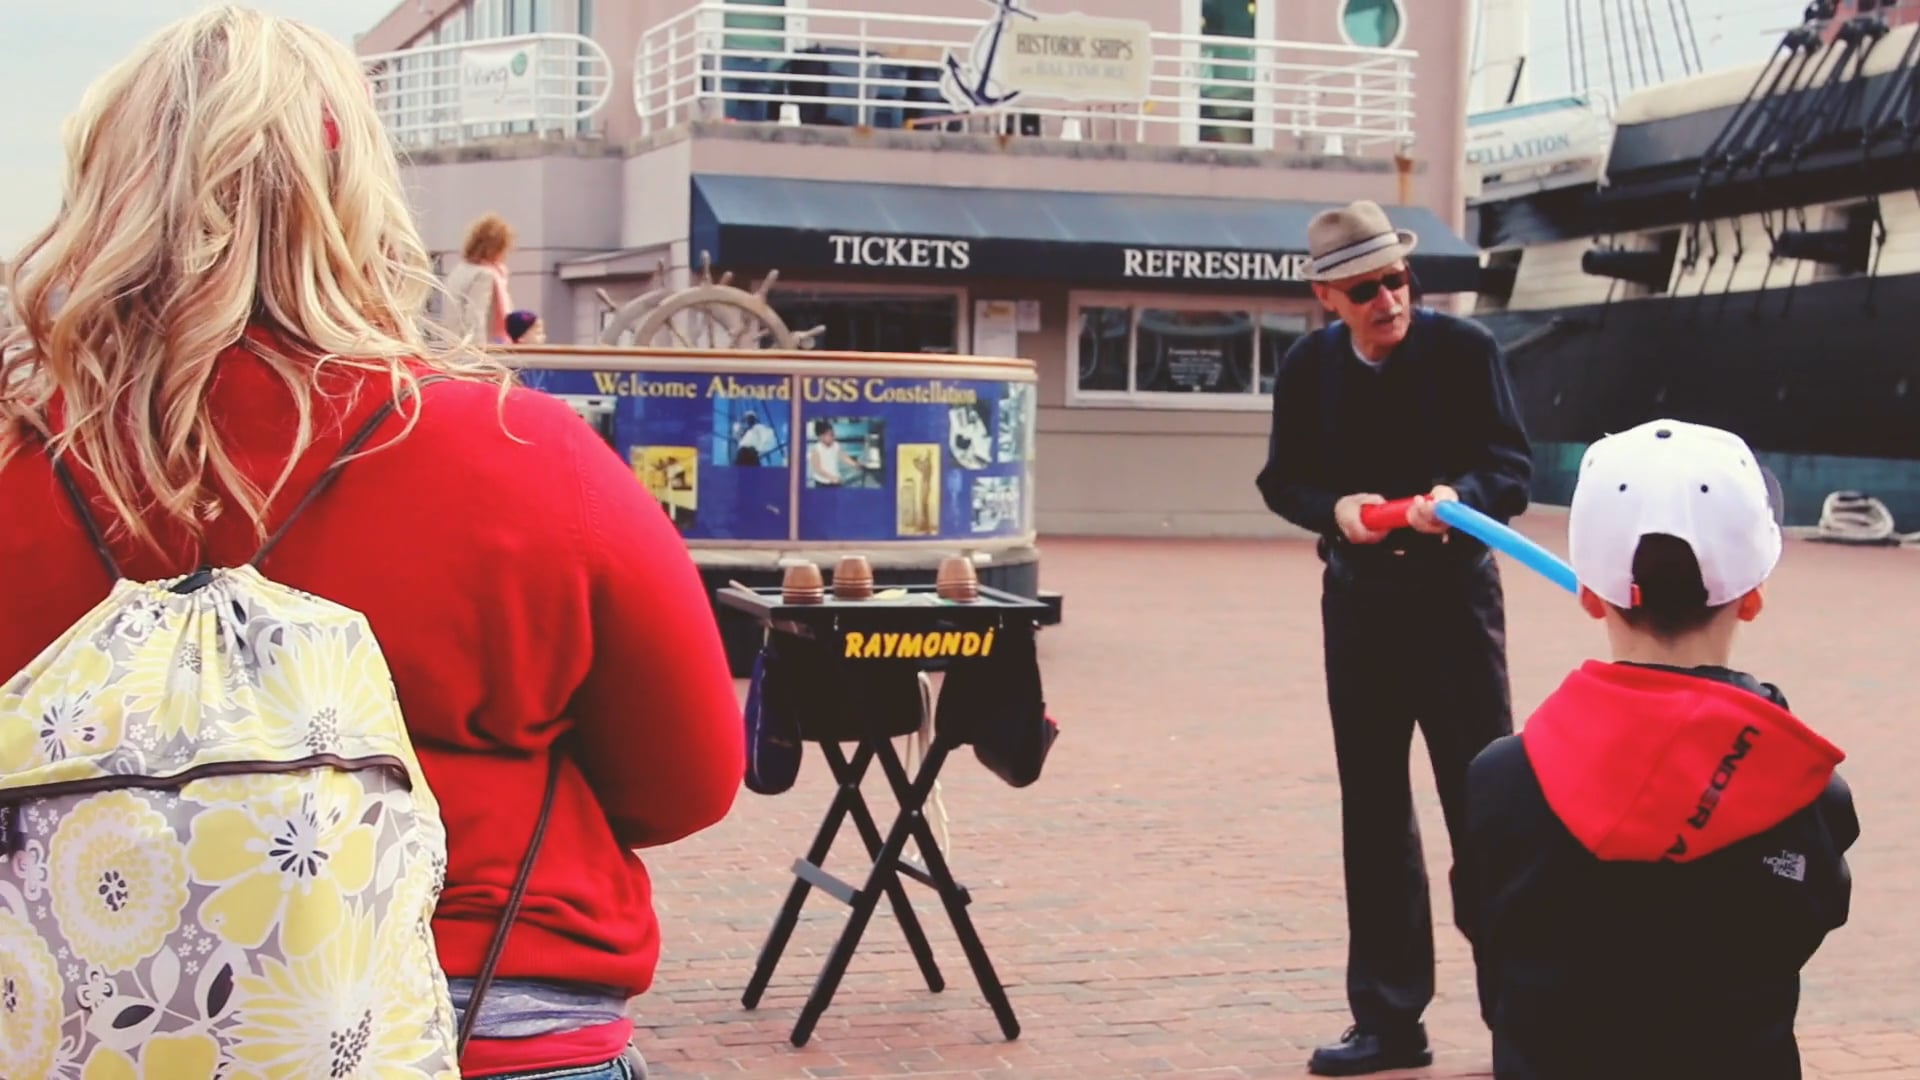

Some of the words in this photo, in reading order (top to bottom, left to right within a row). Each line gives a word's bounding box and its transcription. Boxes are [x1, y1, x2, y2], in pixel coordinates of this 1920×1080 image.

[1016, 33, 1085, 57] HISTORIC
[1090, 38, 1134, 61] SHIPS
[1466, 134, 1570, 164] ELLATION
[828, 235, 970, 270] TICKETS
[593, 371, 698, 399] Welcome
[706, 375, 790, 400] Aboard
[802, 377, 859, 402] USS
[864, 378, 977, 404] Constellation
[1686, 725, 1761, 830] UNDER
[1661, 832, 1688, 861] A
